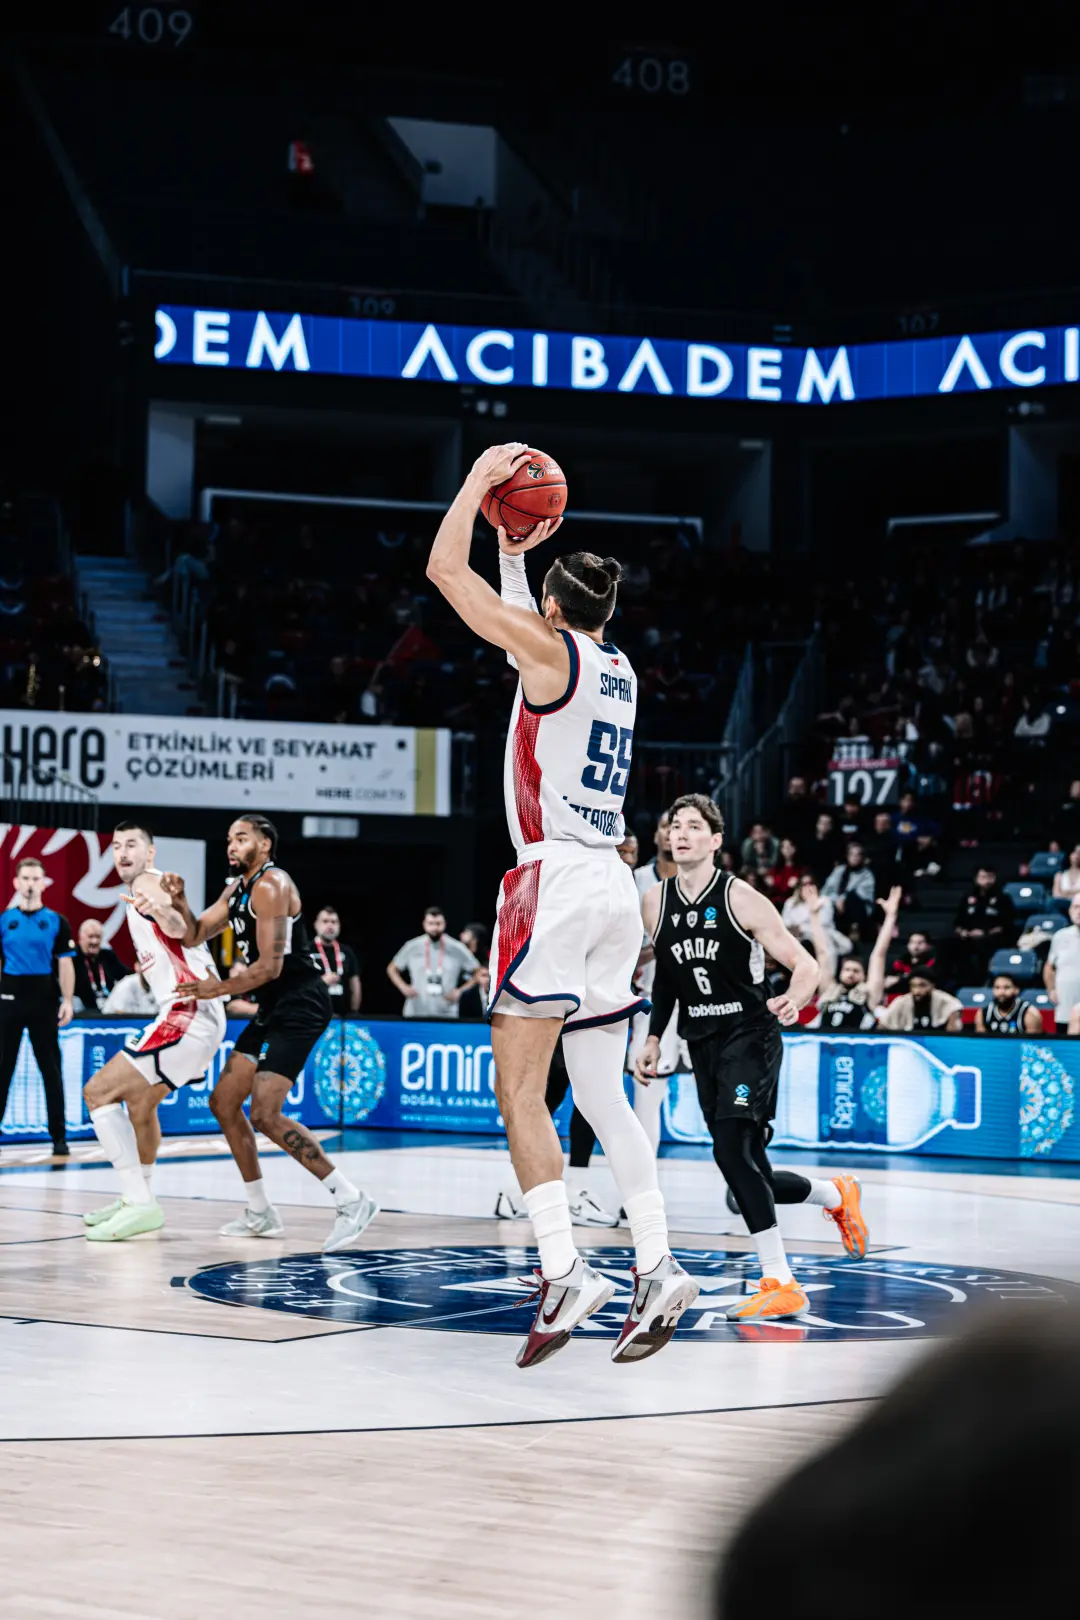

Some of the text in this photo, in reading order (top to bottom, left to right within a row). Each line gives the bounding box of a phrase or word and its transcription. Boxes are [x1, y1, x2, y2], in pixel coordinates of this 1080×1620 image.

[108, 9, 194, 49] 409
[612, 56, 690, 96] 408
[401, 324, 855, 404] ACIBADEM
[938, 327, 1080, 393] ACI
[127, 730, 377, 760] ETKİNLİK VE SEYAHAT
[581, 719, 633, 796] 55
[125, 756, 275, 783] ÇÖZÜMLERİ
[829, 769, 898, 806] 107
[670, 937, 720, 965] PAOK
[692, 966, 713, 996] 6
